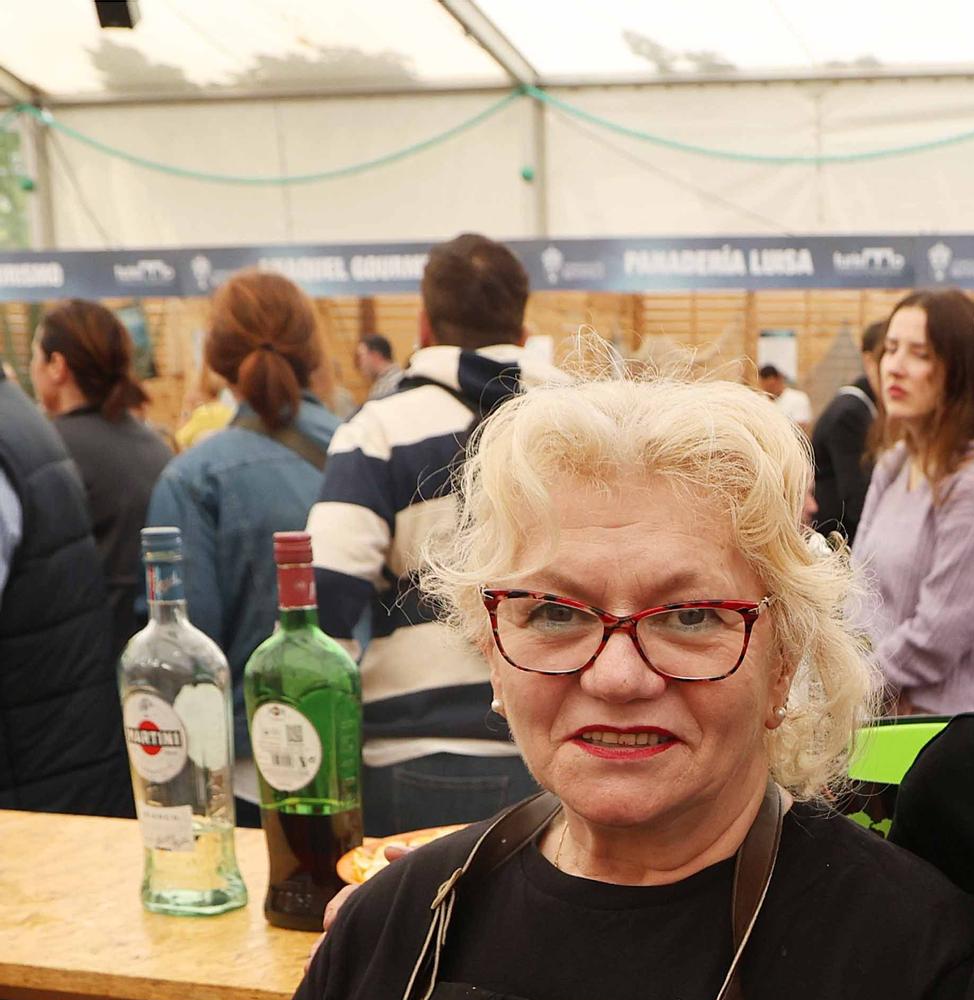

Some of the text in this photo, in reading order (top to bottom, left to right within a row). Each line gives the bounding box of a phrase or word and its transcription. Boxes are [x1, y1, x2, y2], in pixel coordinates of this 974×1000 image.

[623, 244, 747, 277] PANADERÍA
[748, 247, 815, 277] LUISA
[126, 727, 182, 747] MARTINI
